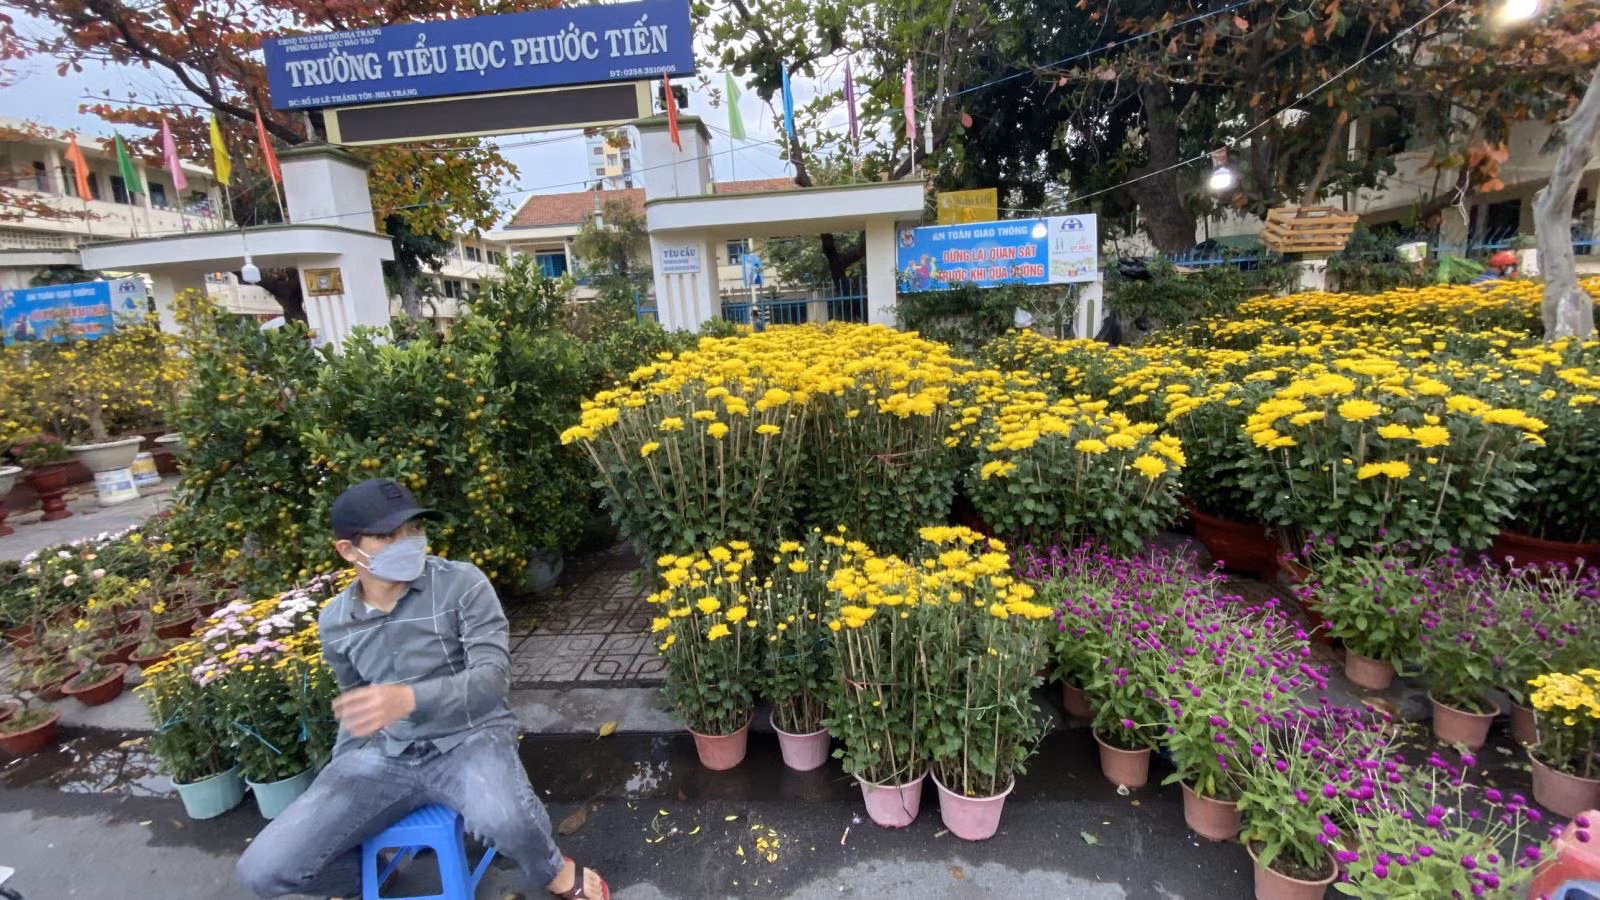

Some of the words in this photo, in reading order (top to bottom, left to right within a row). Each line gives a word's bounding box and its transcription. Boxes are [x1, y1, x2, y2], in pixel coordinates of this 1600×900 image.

[355, 29, 381, 38] TRANG
[285, 48, 383, 88] TRƯỜNG
[387, 33, 448, 78] TIỂU
[452, 41, 506, 76] HỌC
[511, 22, 600, 67] PHƯỚC
[604, 13, 668, 58] TIẾN
[391, 88, 418, 98] TRANG
[973, 228, 995, 239] GIAO
[997, 225, 1028, 237] THÔNG
[663, 249, 679, 258] YÊU
[990, 246, 1017, 261] QUAN
[1017, 241, 1037, 259] SÁT
[969, 267, 987, 281] KHI
[989, 265, 1008, 280] QUA
